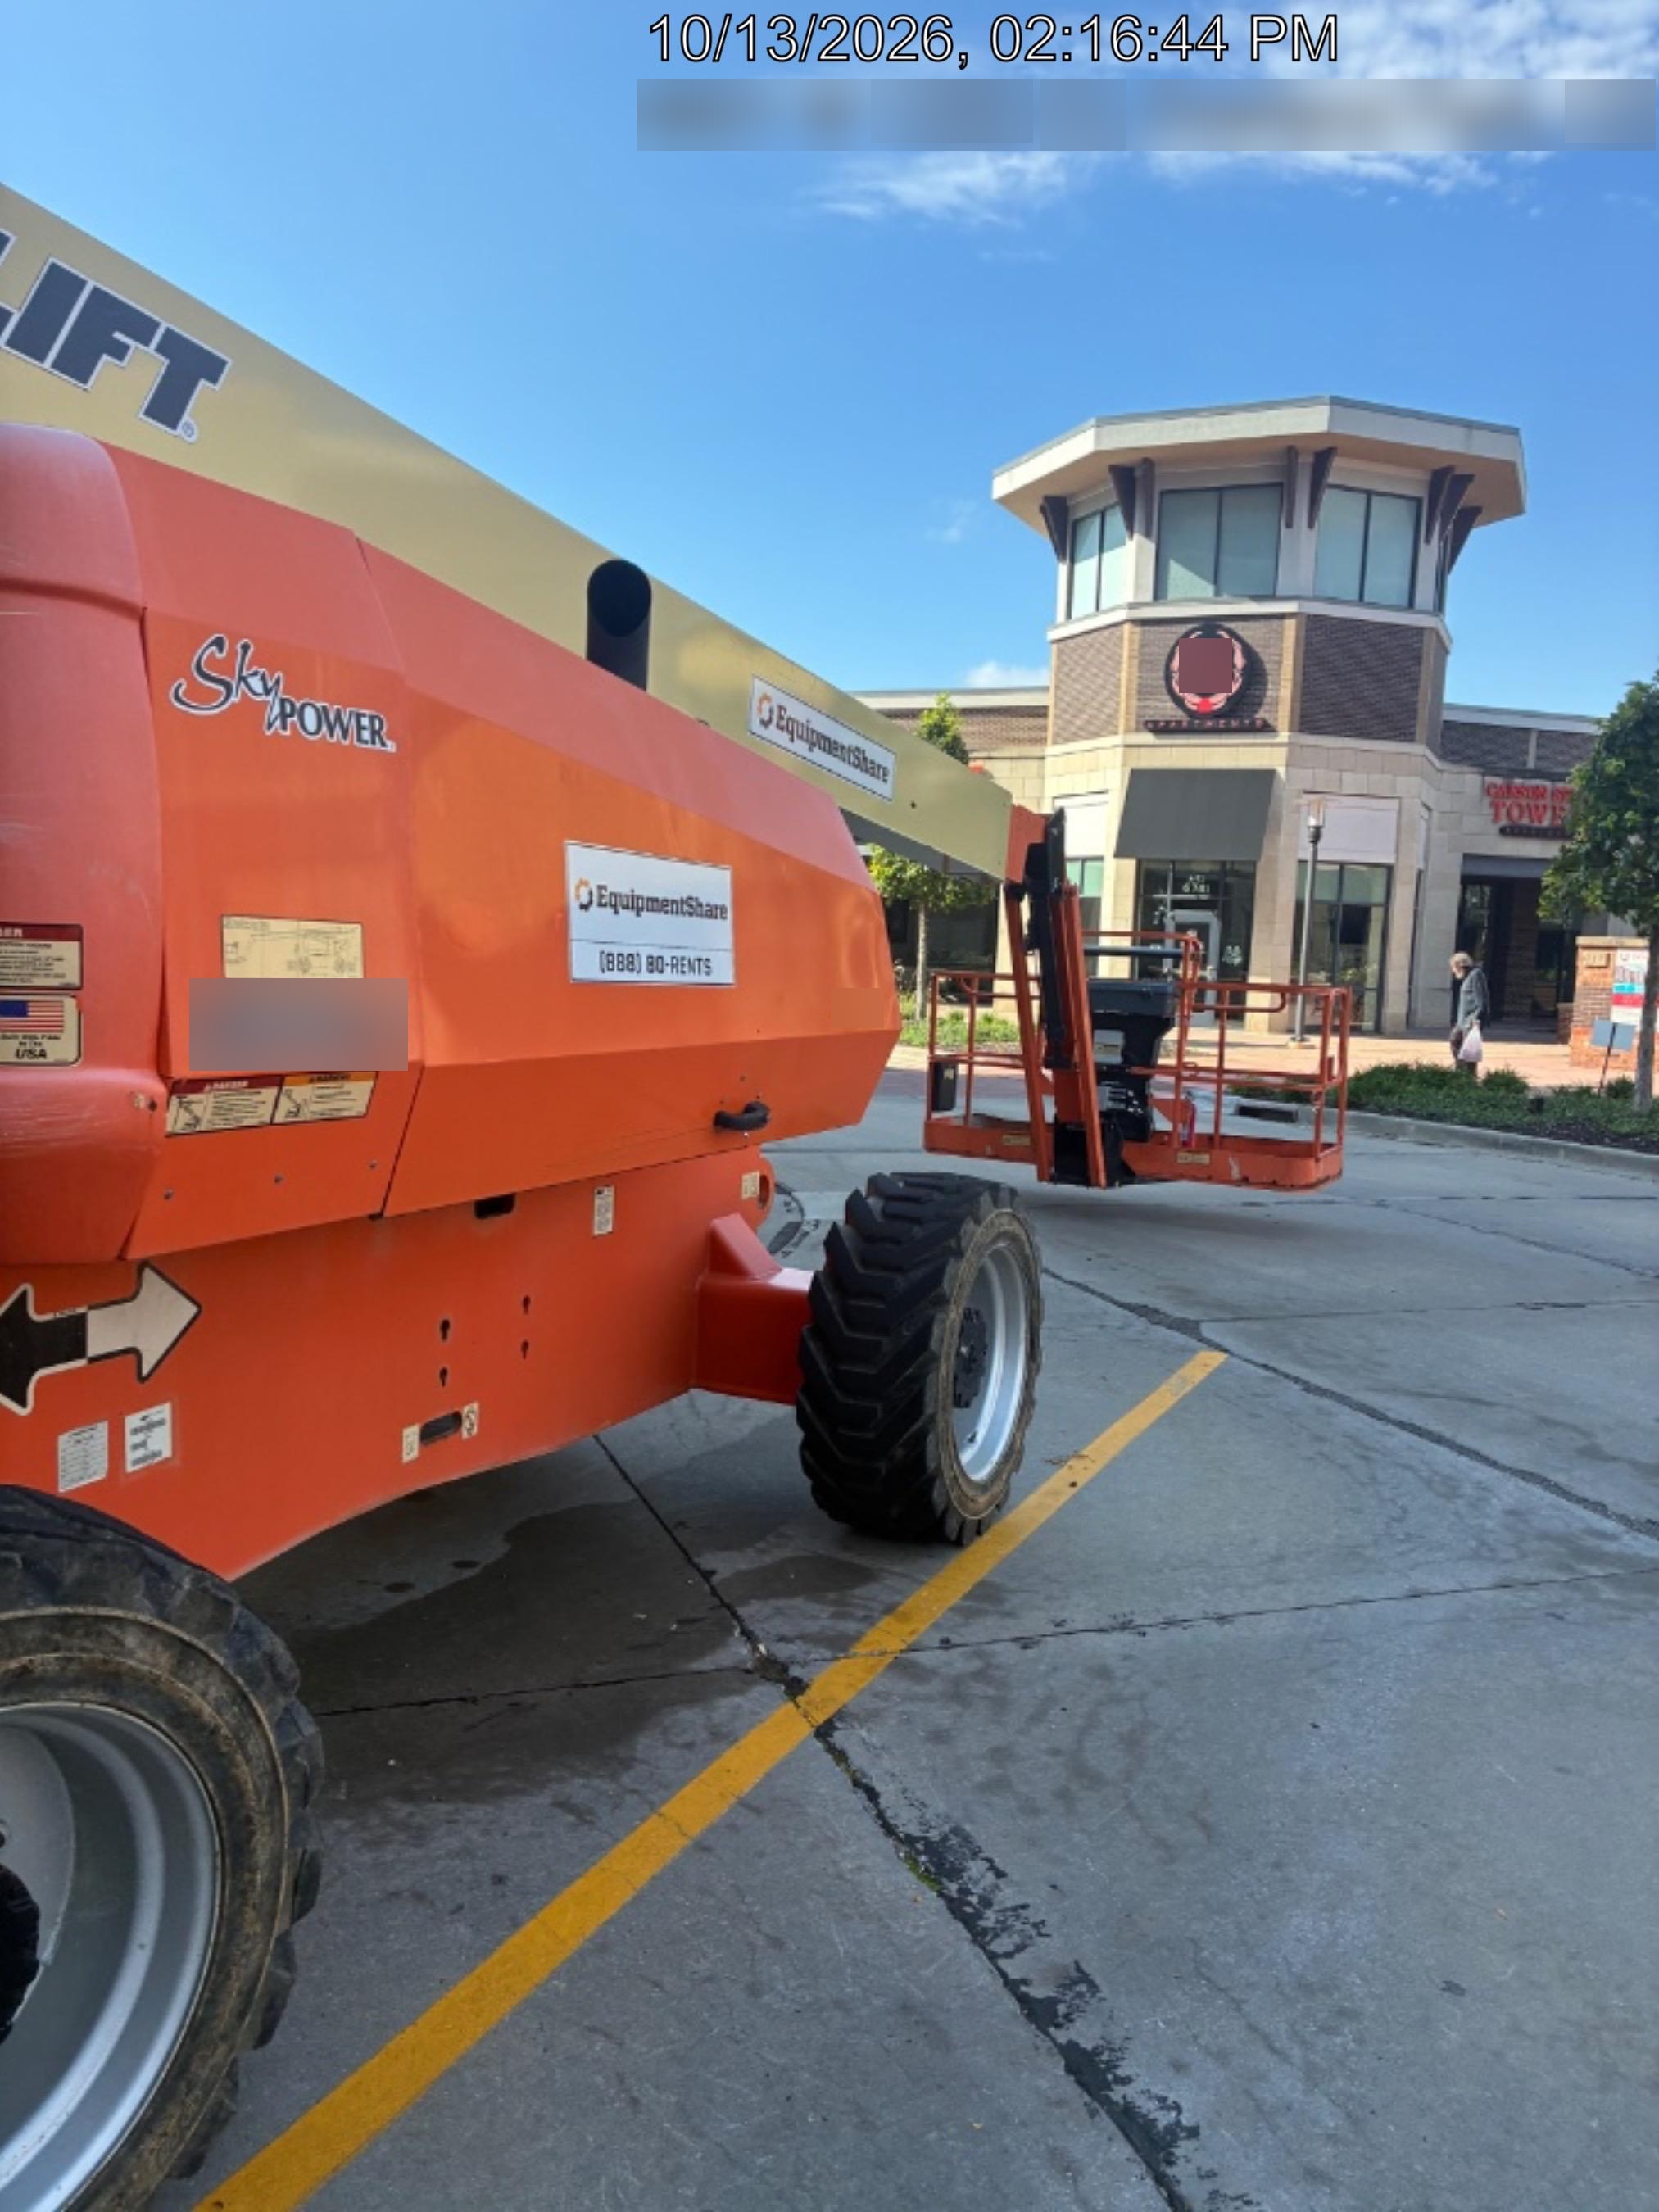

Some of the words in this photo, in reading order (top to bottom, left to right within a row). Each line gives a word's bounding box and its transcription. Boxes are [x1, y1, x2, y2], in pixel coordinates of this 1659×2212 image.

[170, 634, 282, 734] Sky
[276, 696, 388, 748] POWER
[775, 704, 891, 784] EquipmentShare
[596, 884, 728, 920] EquipmentShare
[599, 950, 642, 974] (888)
[646, 954, 713, 977] 80-RENTS
